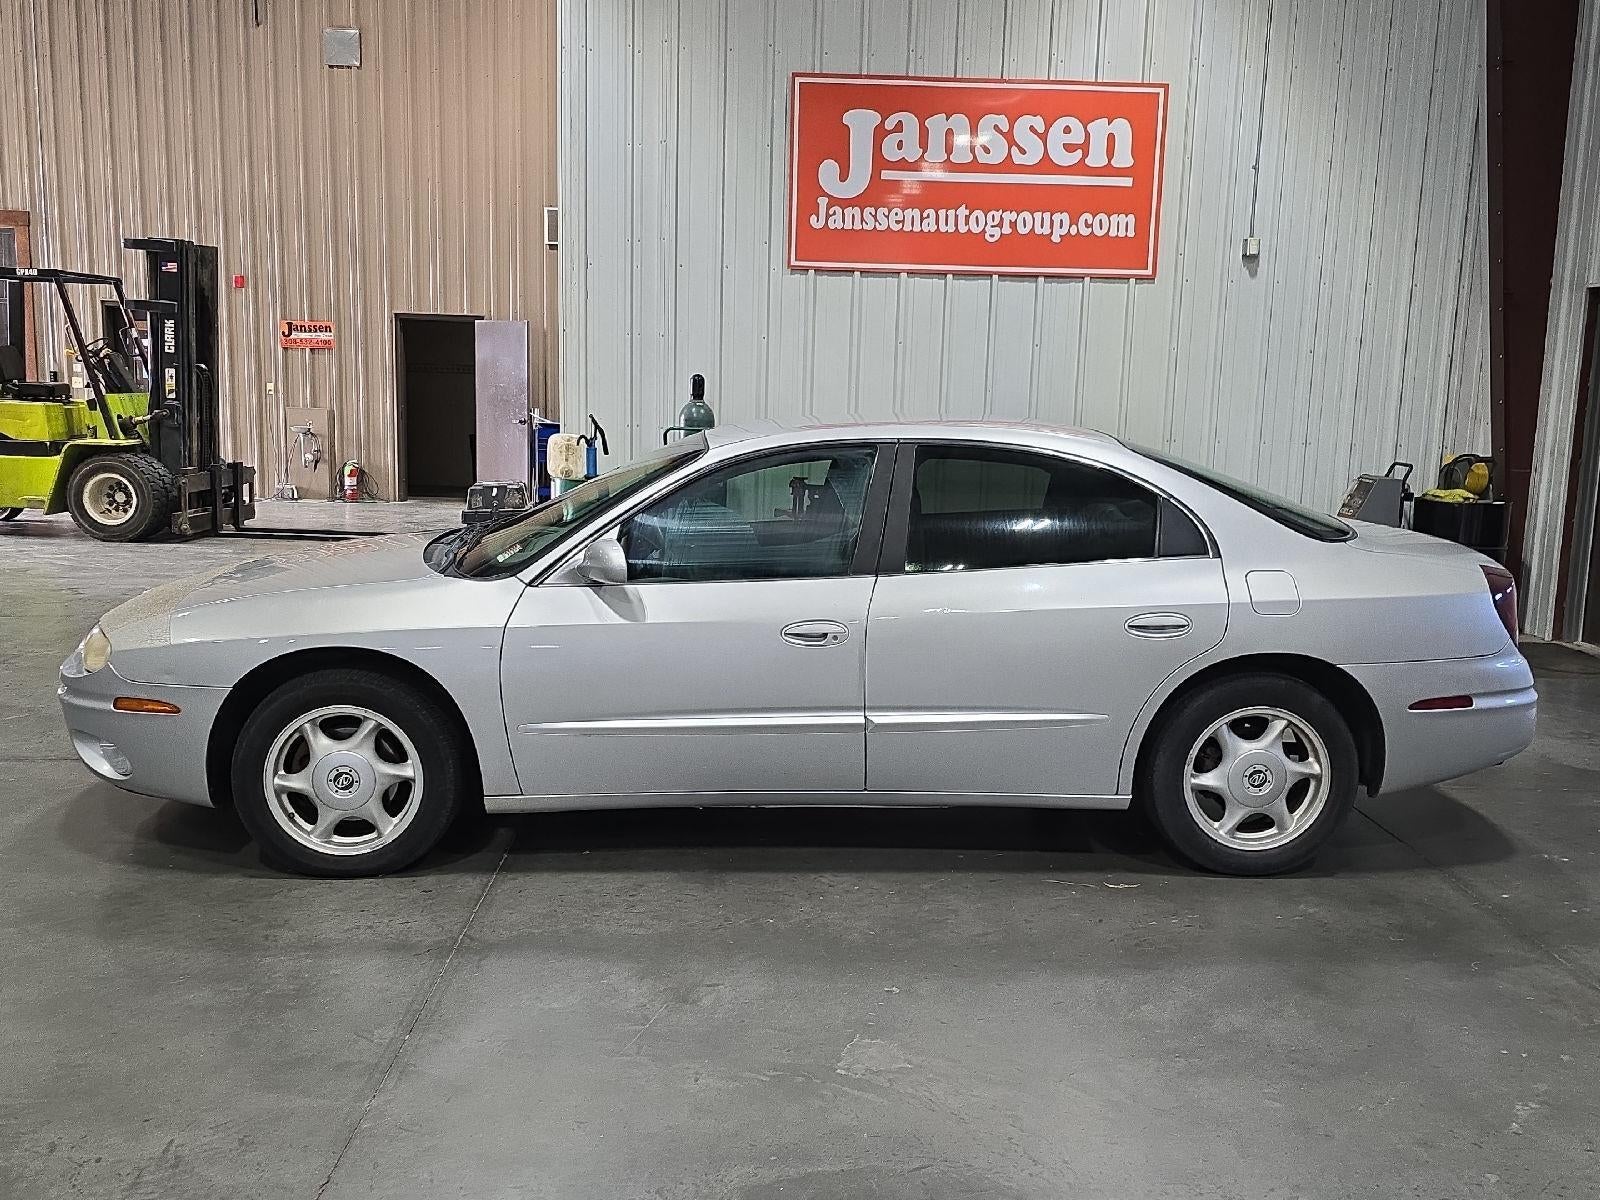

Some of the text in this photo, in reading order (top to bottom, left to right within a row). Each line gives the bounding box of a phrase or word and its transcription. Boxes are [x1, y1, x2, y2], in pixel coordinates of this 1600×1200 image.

[818, 109, 1134, 198] Janssen
[810, 197, 1136, 243] Janssenautogroup.com
[164, 319, 175, 353] CLARK
[282, 322, 332, 338] Janssen
